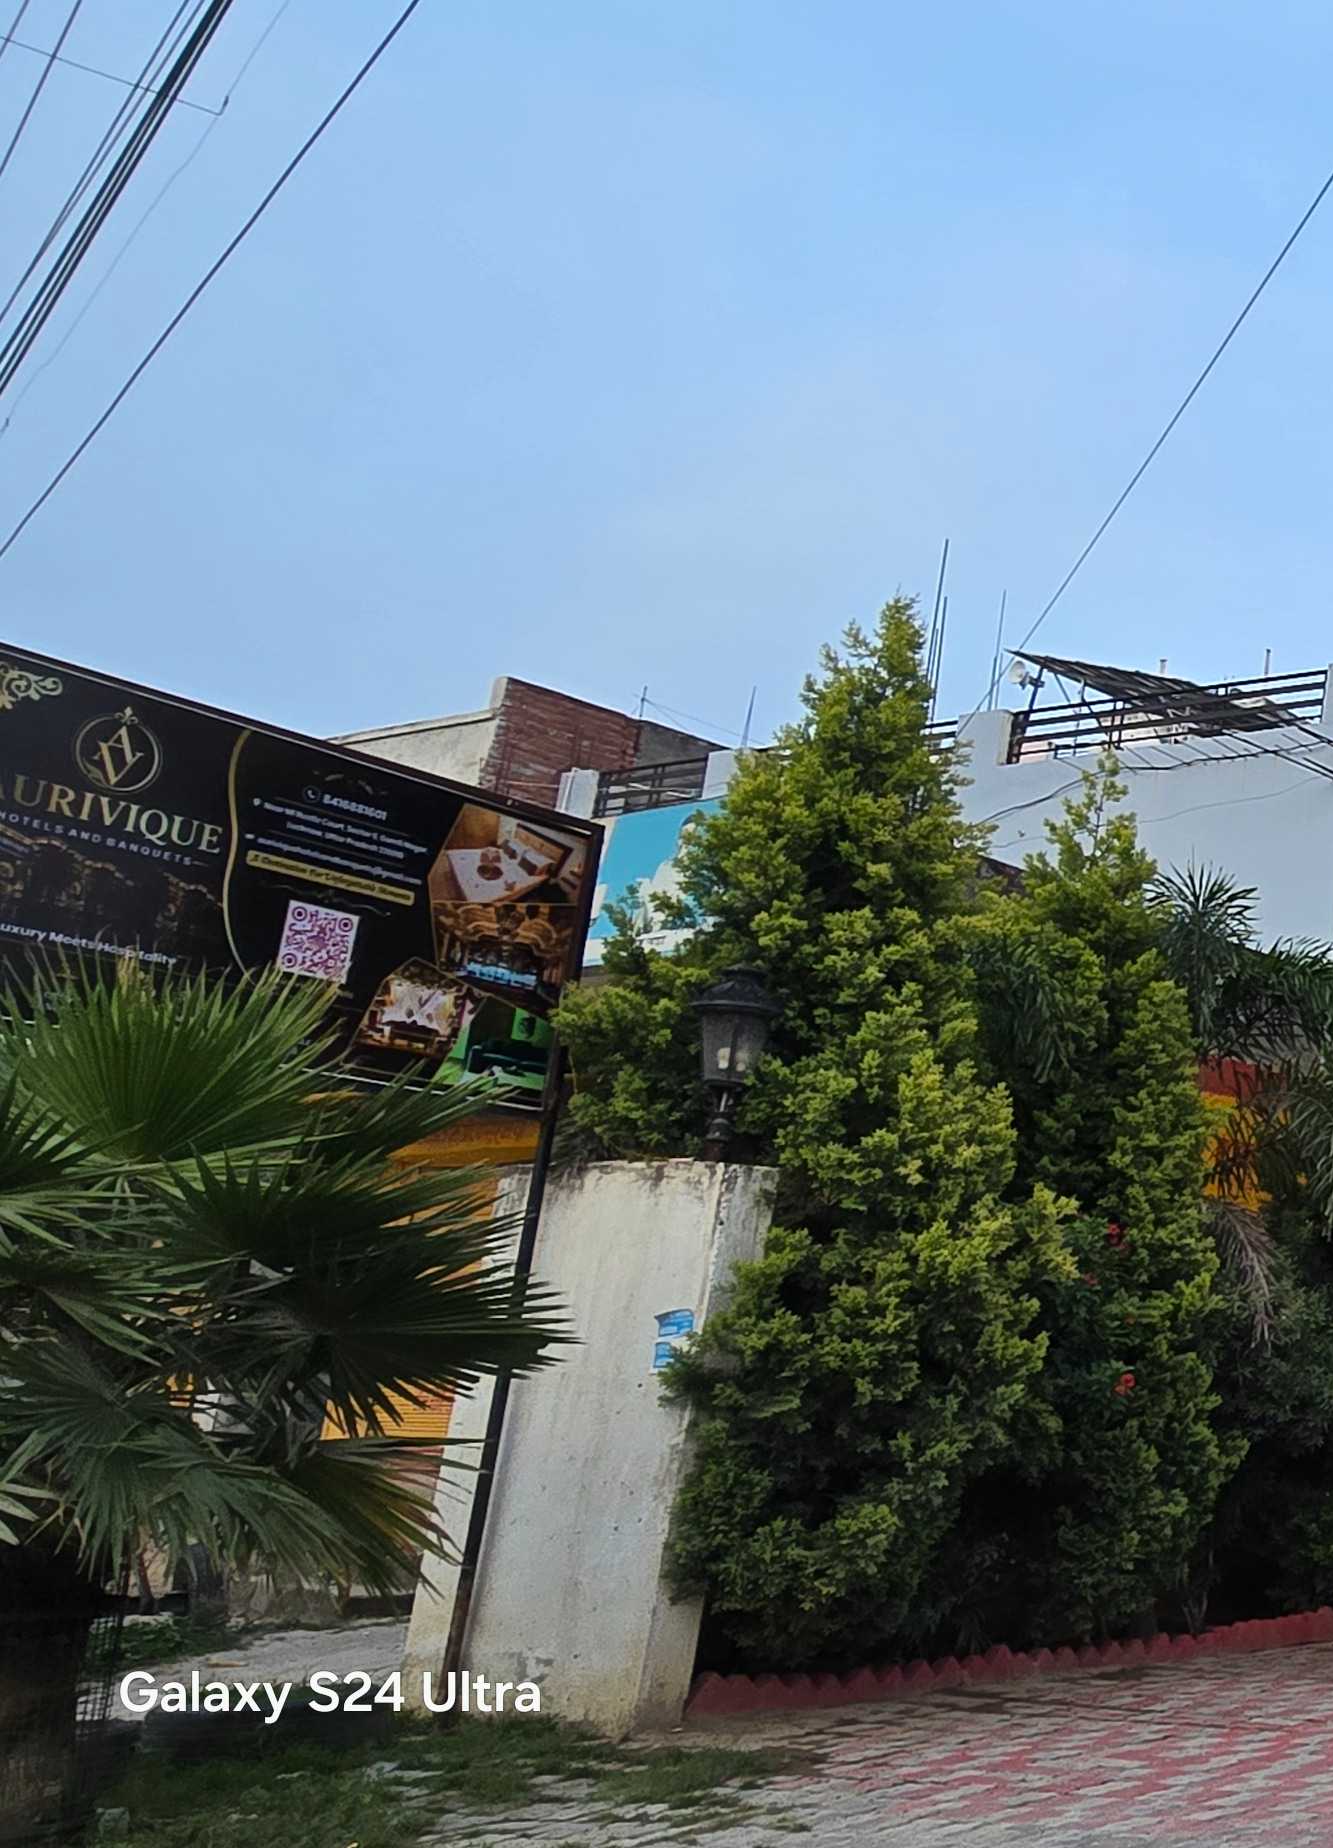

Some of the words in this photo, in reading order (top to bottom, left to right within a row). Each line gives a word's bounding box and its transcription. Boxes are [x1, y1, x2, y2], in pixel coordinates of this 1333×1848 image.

[0, 774, 224, 854] URIVIQUE
[67, 828, 102, 844] AND
[105, 837, 192, 866] BANQUETS
[0, 922, 47, 941] uxury
[97, 941, 177, 966] Hosptality
